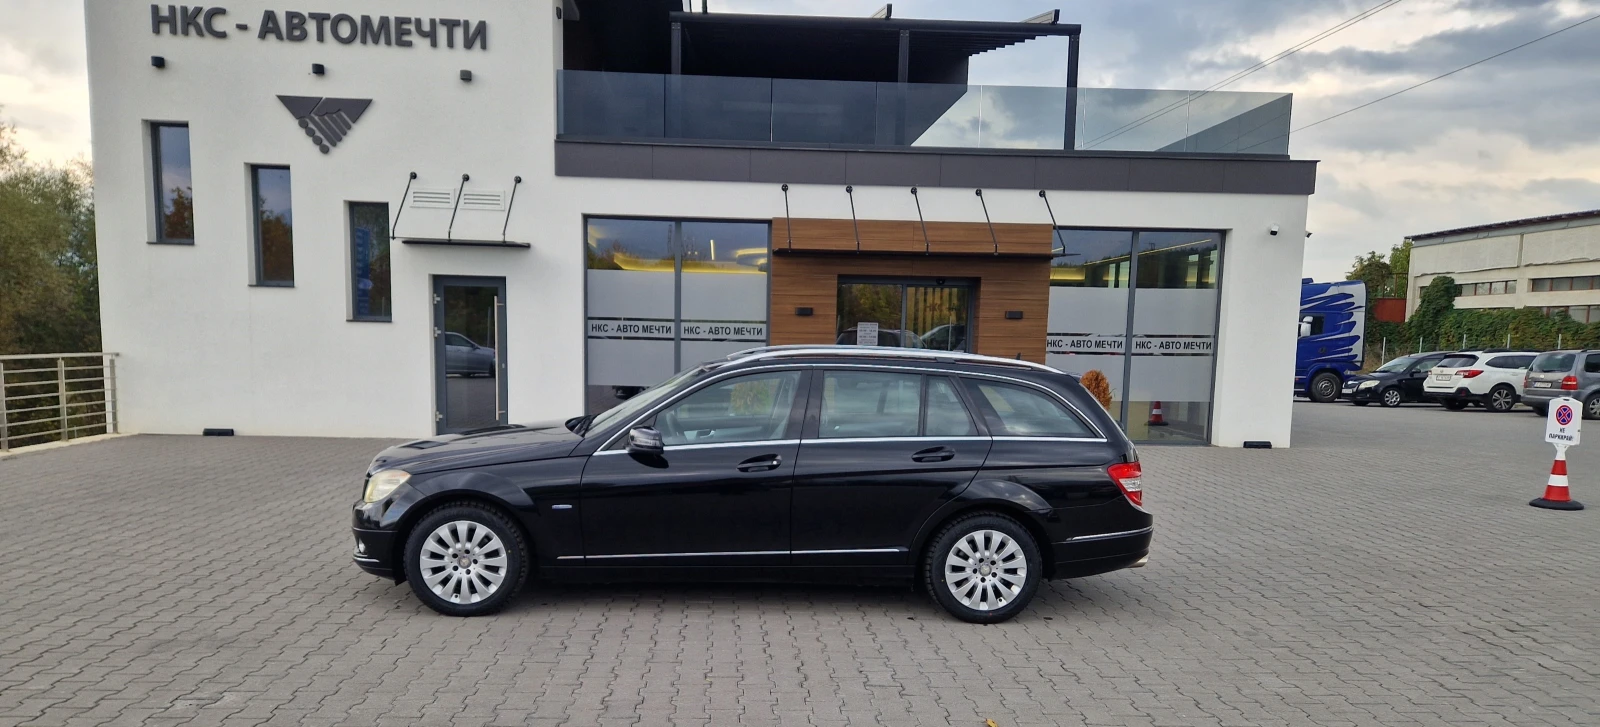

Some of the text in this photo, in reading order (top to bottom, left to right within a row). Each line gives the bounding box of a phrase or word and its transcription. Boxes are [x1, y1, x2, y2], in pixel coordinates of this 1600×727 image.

[151, 4, 227, 38] НКС
[257, 9, 487, 50] АВТОМЕЧТИ
[591, 323, 609, 333] НКС
[616, 324, 640, 334] АВТО
[642, 325, 672, 335] МЕЧТИ
[683, 326, 701, 335] НКС
[708, 327, 732, 336] АВТО
[734, 327, 763, 337] МЕЧТИ
[1046, 339, 1063, 349] НКС
[1069, 340, 1093, 349] АВТО
[1094, 340, 1123, 350] МЕЧТИ
[1135, 341, 1152, 350] НКС
[1158, 341, 1182, 350] АВТО
[1183, 341, 1212, 351] МЕЧТИ
